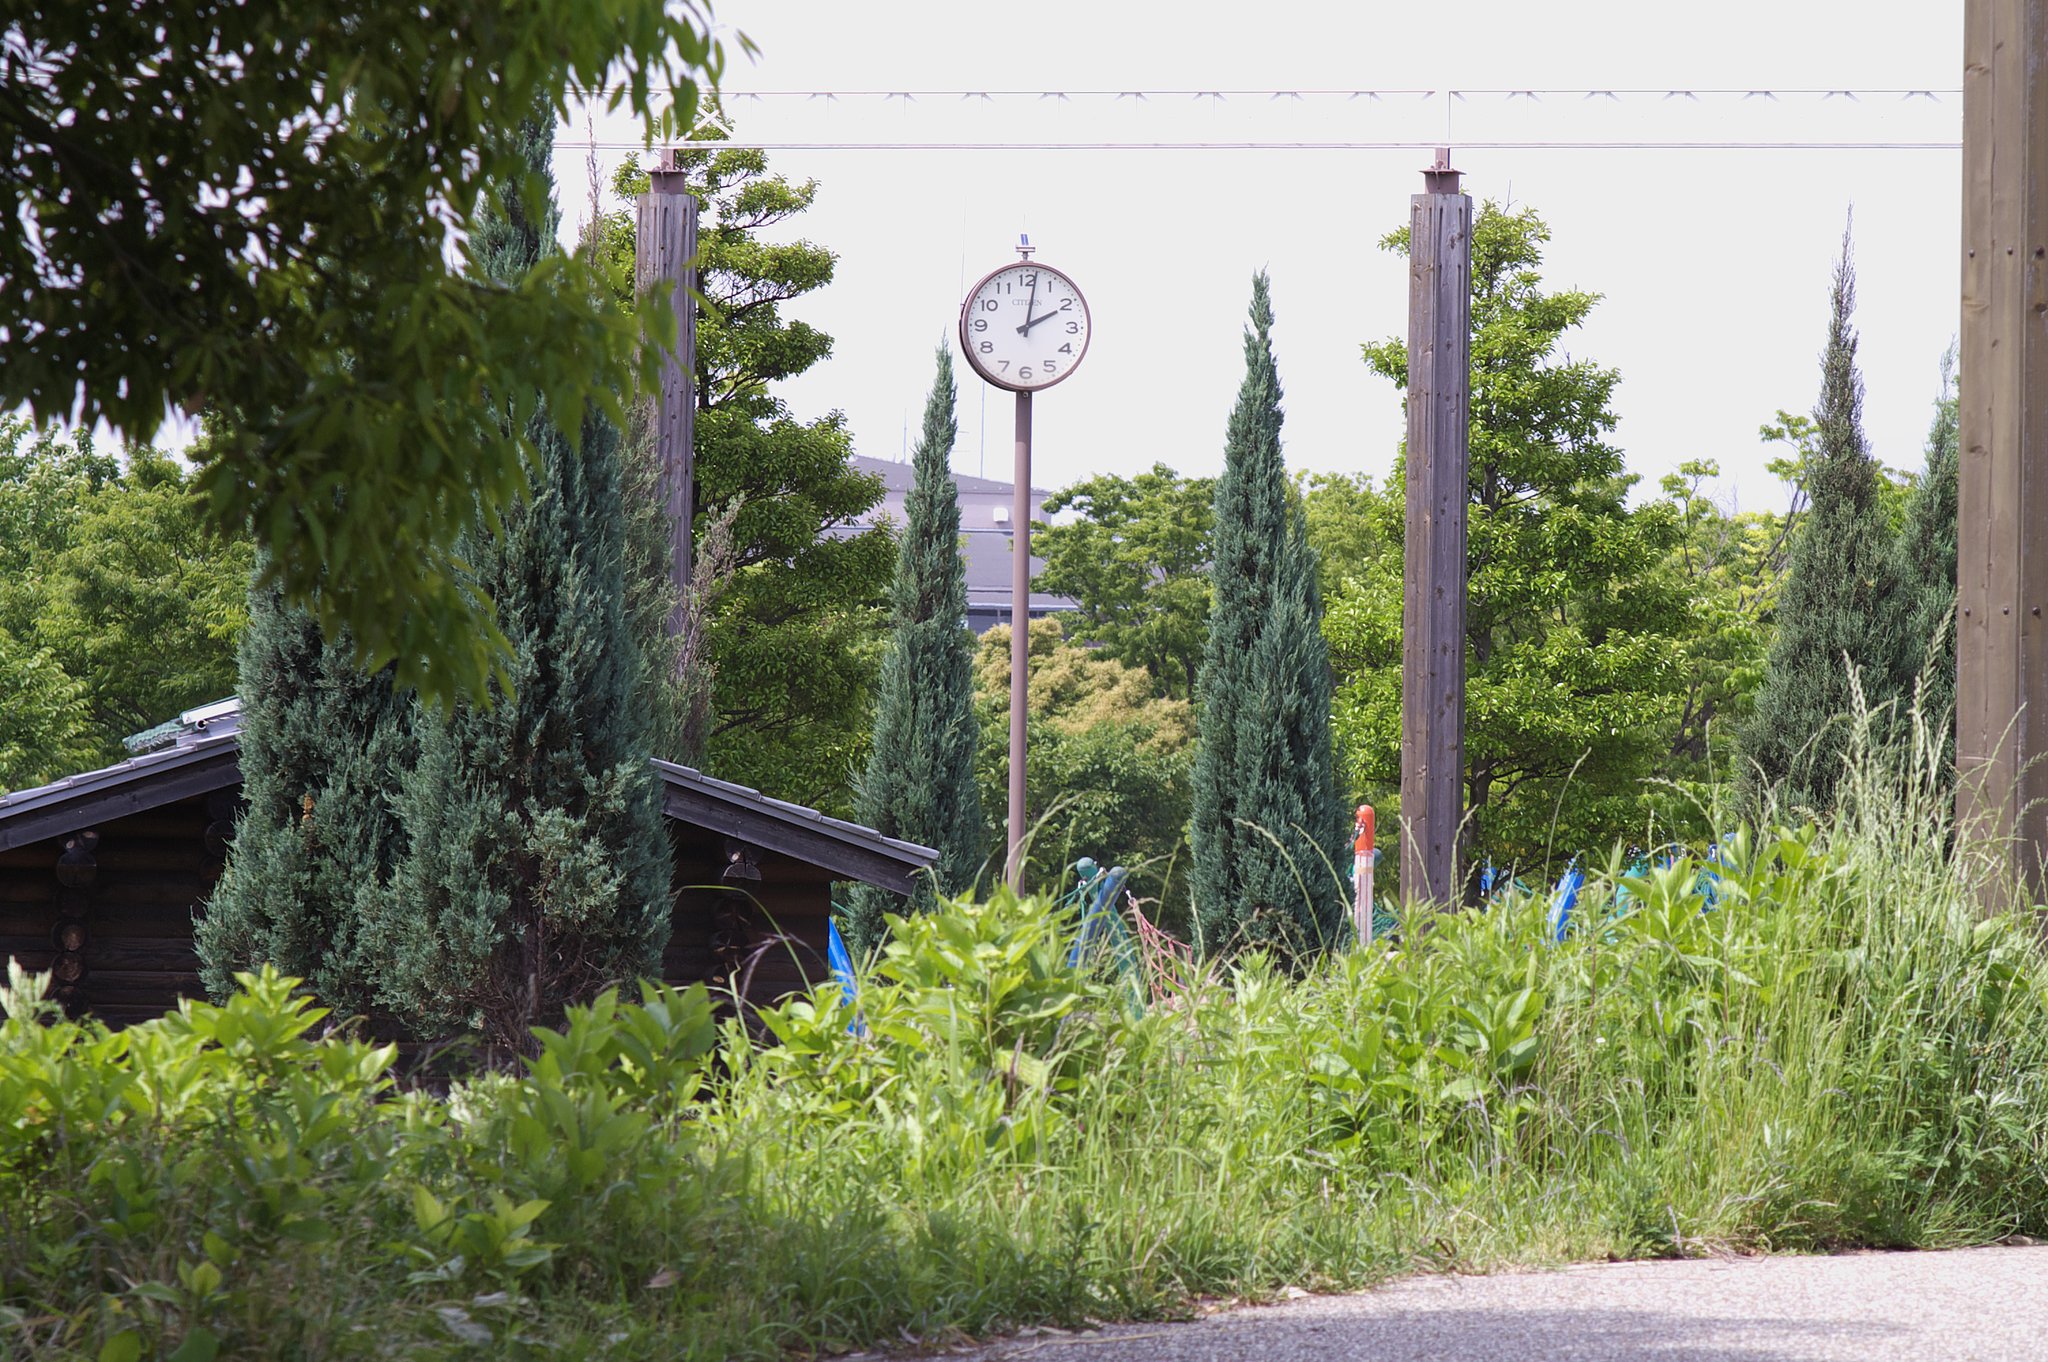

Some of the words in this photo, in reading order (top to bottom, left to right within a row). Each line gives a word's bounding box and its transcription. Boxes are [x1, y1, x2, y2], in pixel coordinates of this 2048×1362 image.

[1019, 274, 1036, 287] 12
[996, 282, 1011, 294] 11
[1047, 281, 1052, 293] 1
[981, 299, 998, 312] 10
[1060, 298, 1072, 310] 2
[975, 319, 987, 332] 9
[1066, 322, 1078, 334] 3
[980, 341, 993, 353] 8
[1057, 342, 1072, 355] 4
[998, 360, 1010, 372] 7
[1044, 360, 1056, 373] 5
[1019, 366, 1033, 379] 6
